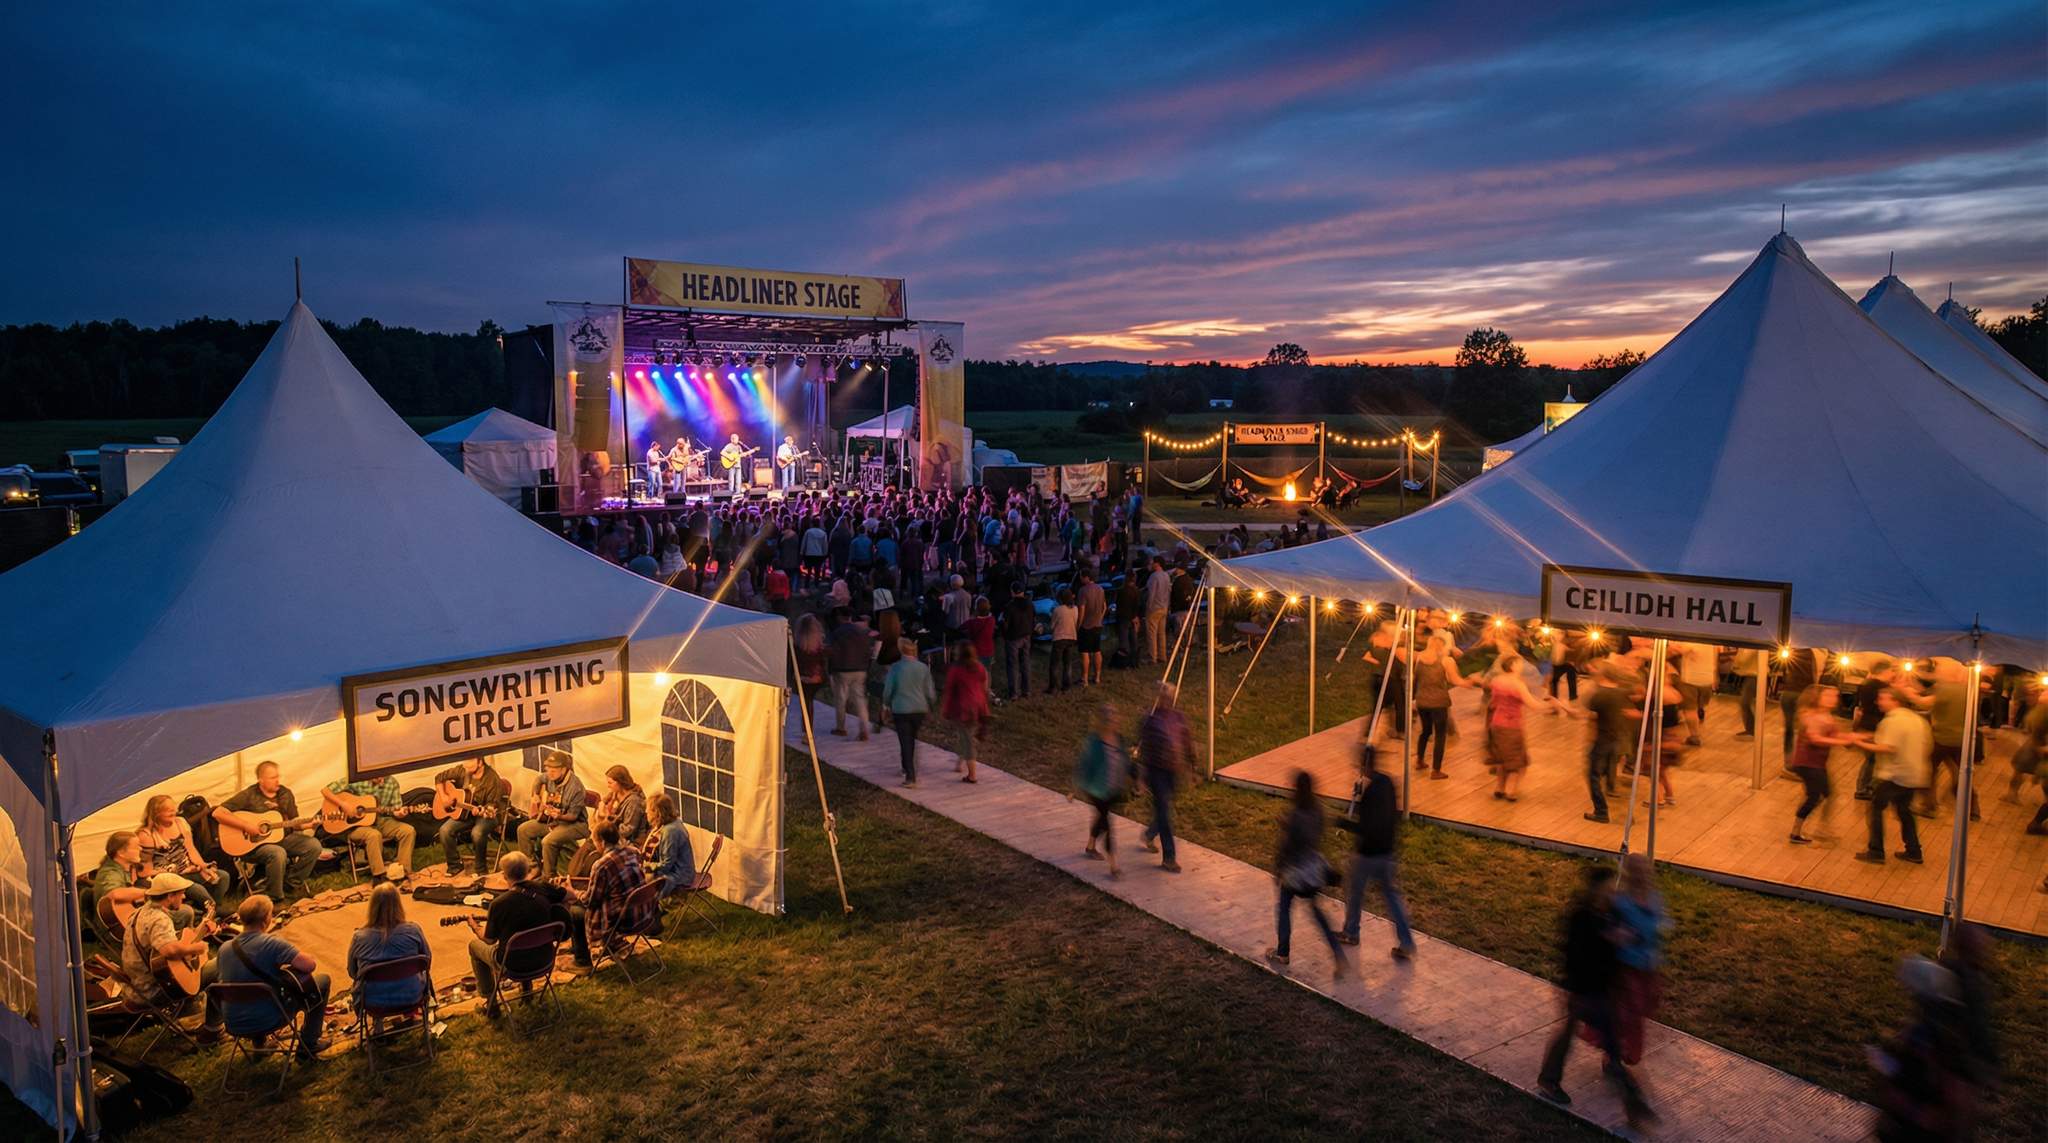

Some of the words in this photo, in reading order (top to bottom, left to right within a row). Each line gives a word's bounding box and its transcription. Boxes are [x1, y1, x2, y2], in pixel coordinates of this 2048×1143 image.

[682, 272, 798, 306] HEADLINER
[804, 282, 861, 309] STAGE
[1566, 587, 1675, 618] CEILIDH
[1686, 597, 1763, 626] HALL
[375, 659, 605, 722] SONGWRITING
[443, 700, 552, 744] CIRCLE
